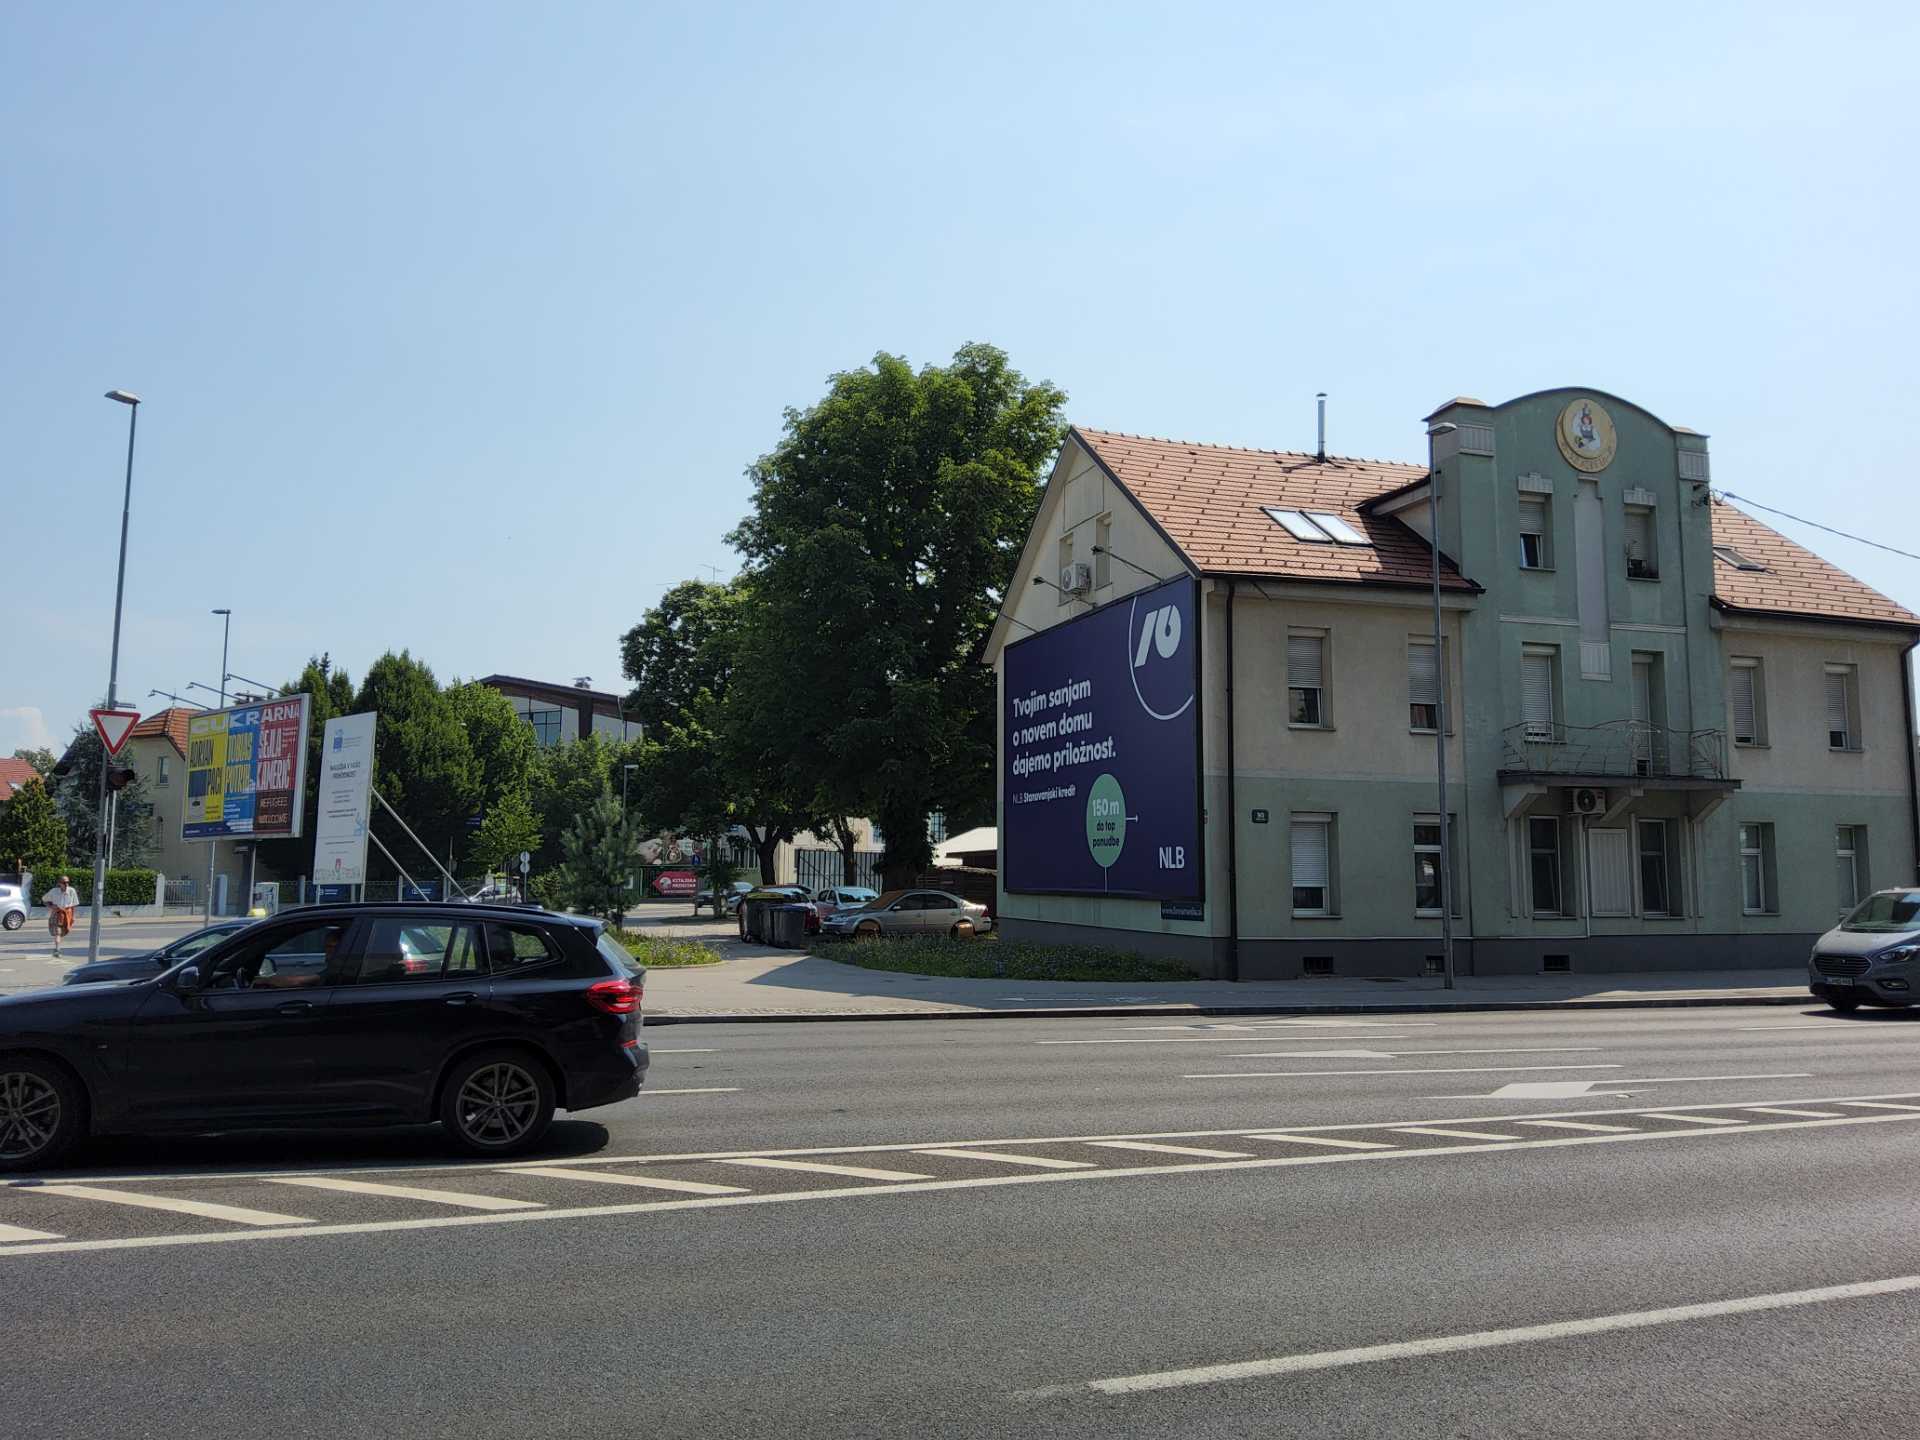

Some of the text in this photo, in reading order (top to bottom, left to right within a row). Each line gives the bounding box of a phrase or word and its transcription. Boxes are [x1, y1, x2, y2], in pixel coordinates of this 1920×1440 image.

[1013, 678, 1091, 718] Tvojim sanjam
[1012, 712, 1092, 747] o novem domu
[1013, 736, 1116, 778] dajemo priložnost.
[1092, 799, 1120, 816] 150 m
[1105, 819, 1116, 832] top
[1092, 836, 1120, 849] ponudbe
[1159, 846, 1185, 869] NLB
